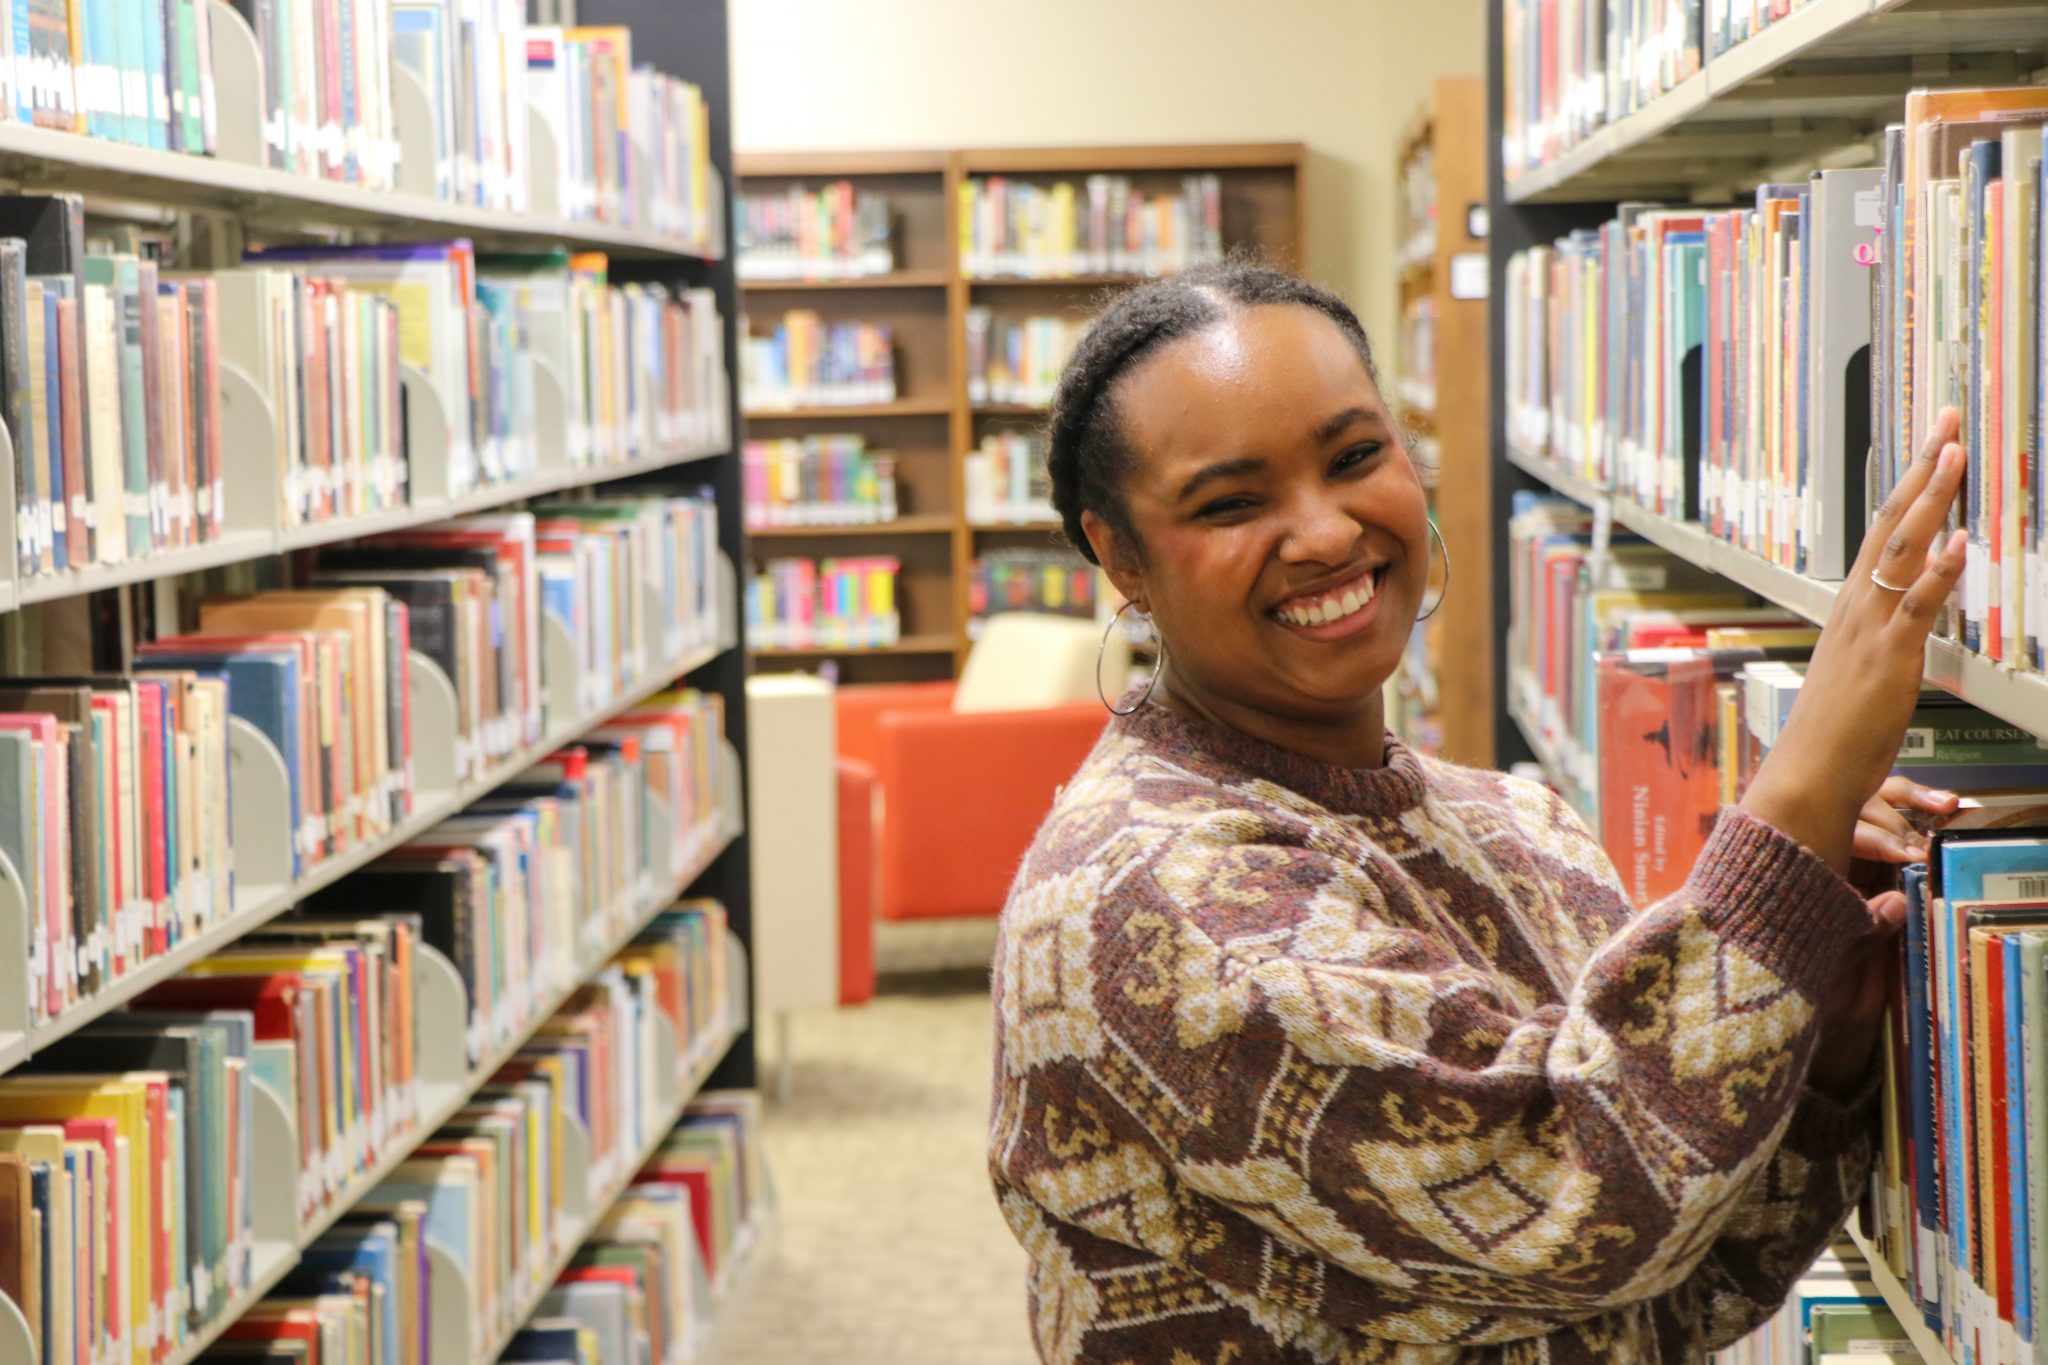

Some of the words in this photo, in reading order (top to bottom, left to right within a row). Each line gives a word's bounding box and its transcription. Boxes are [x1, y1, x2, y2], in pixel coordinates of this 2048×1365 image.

[1901, 290, 1916, 462] Christians
[1963, 728, 2030, 741] COURSES
[1935, 749, 1982, 762] Religion
[1632, 785, 1650, 847] Ninian
[1653, 815, 1667, 855] Edited
[1634, 851, 1650, 903] Smart
[1651, 857, 1667, 873] by
